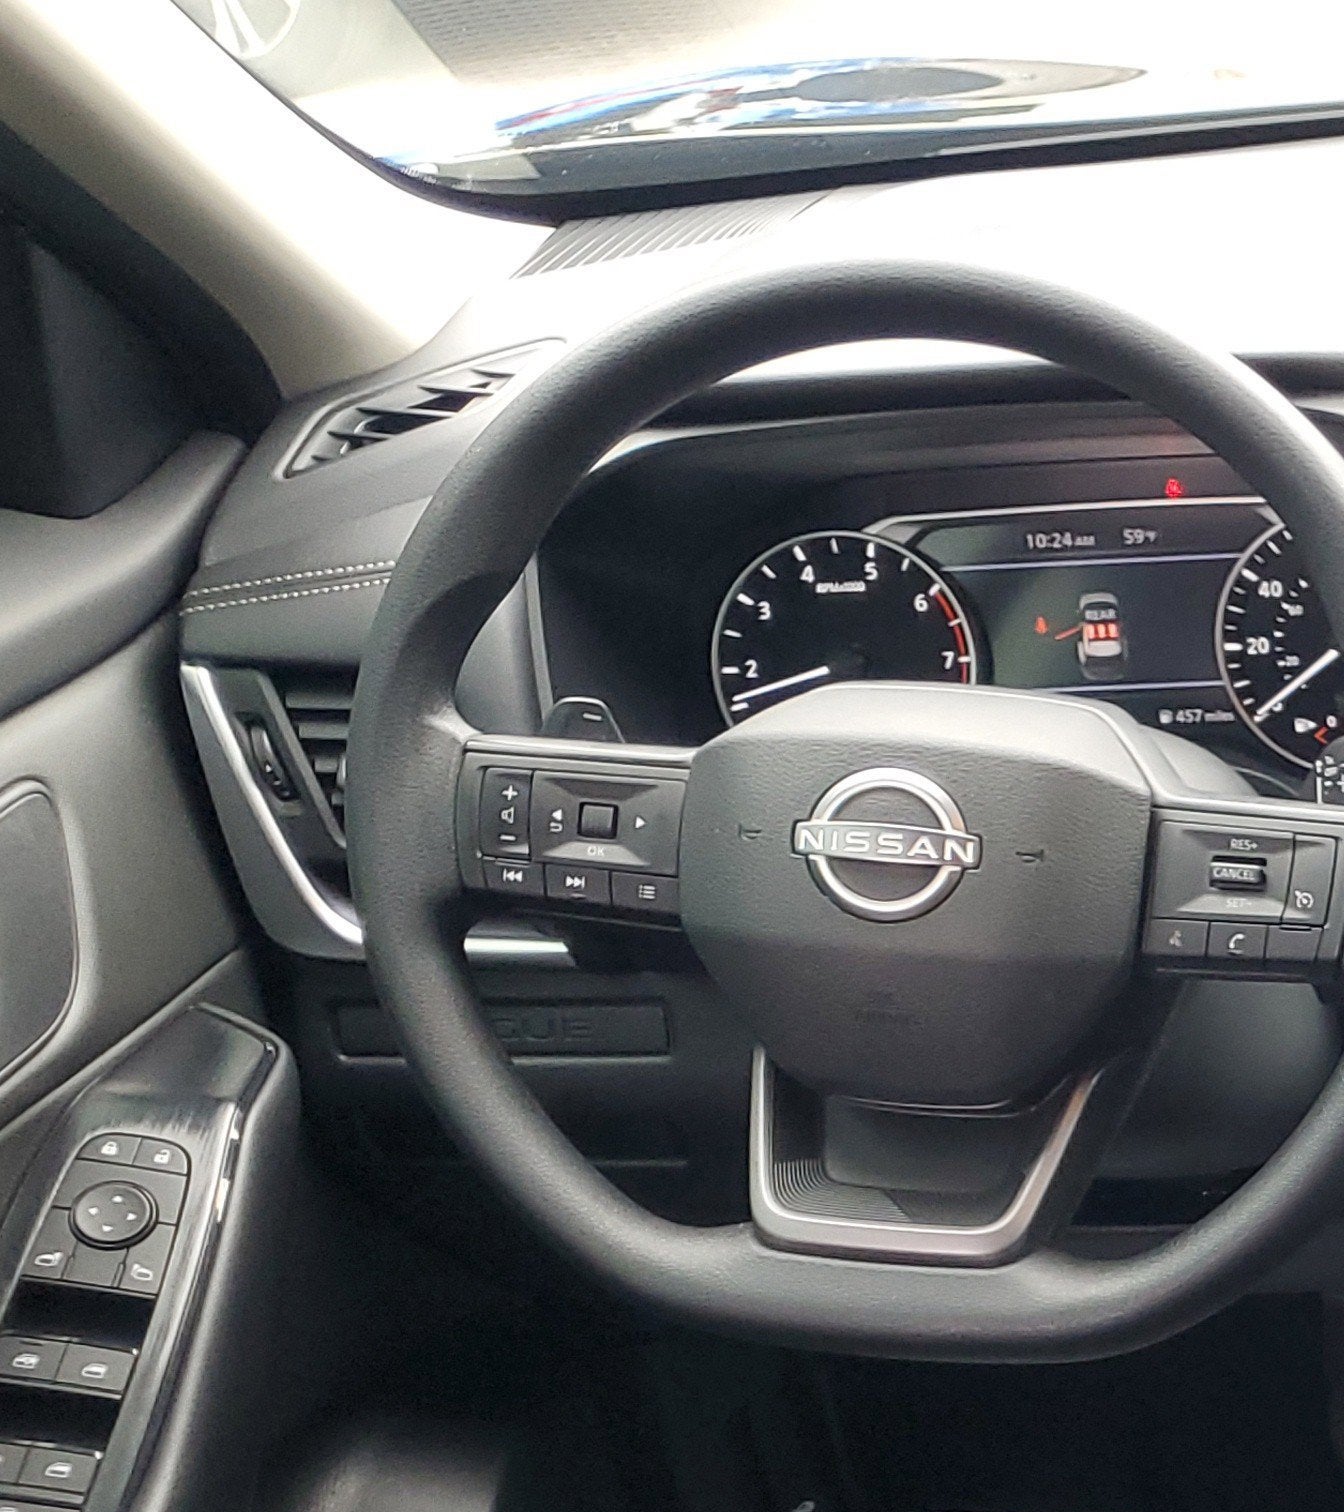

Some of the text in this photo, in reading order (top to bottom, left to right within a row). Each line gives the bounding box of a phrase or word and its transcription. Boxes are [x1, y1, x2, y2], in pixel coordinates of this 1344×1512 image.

[1026, 532, 1073, 549] 10:24
[800, 565, 815, 583] 4
[864, 562, 878, 580] 5
[1258, 580, 1283, 598] 40
[757, 602, 771, 620] 3
[913, 593, 928, 612] 6
[1245, 636, 1270, 655] 20
[744, 660, 759, 678] 2
[941, 651, 954, 670] 7
[1176, 709, 1203, 723] 457
[587, 846, 605, 857] OK
[798, 829, 975, 863] NISSAN
[1213, 867, 1255, 881] CANCEL
